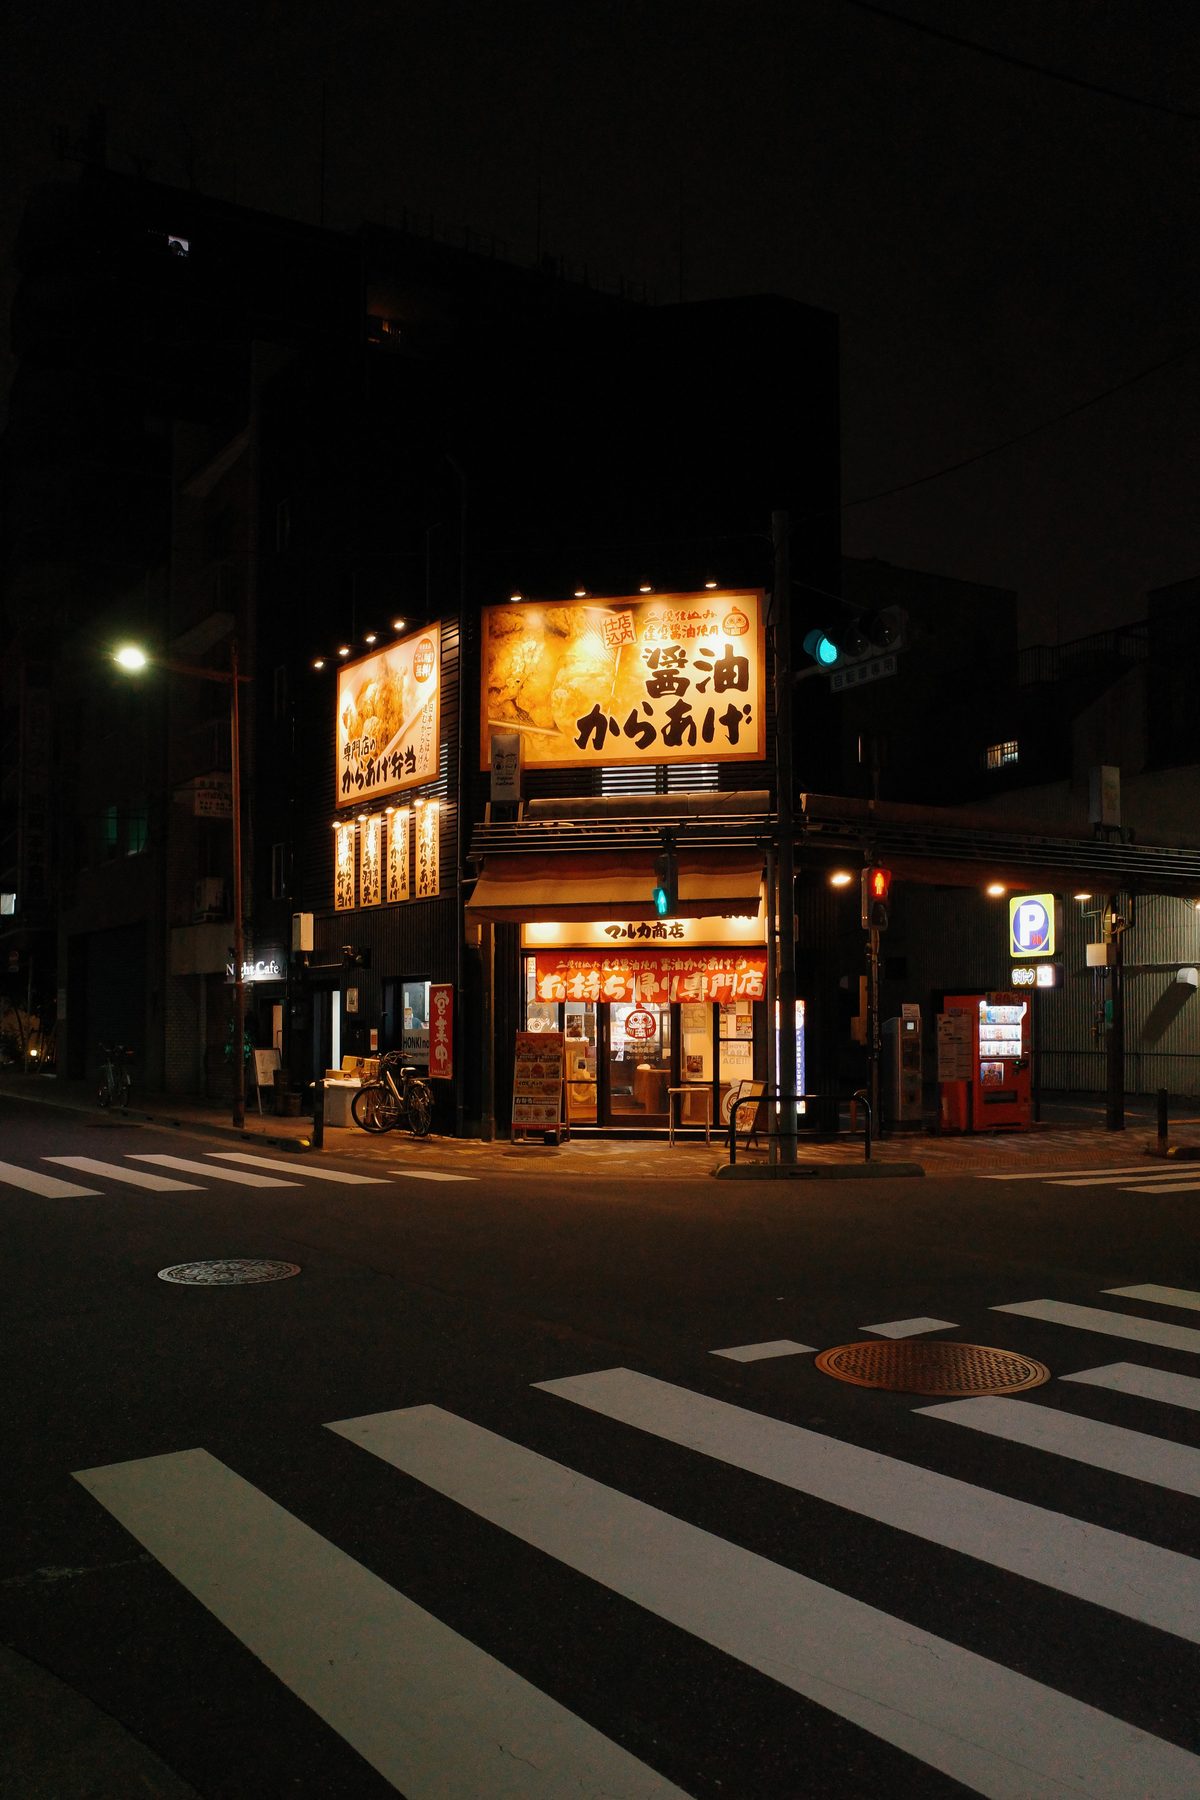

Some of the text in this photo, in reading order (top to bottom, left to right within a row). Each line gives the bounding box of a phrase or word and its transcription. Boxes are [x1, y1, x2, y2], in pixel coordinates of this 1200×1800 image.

[642, 643, 749, 698] 醤油
[574, 698, 752, 750] からあげ
[343, 736, 376, 762] 専門店の
[342, 744, 417, 794] からあげ弁当
[604, 922, 685, 940] マルカ商店
[256, 960, 280, 975] Cafe
[539, 970, 763, 1003] お持ち帰り専門店
[403, 1037, 421, 1049] HONKI
[434, 990, 449, 1069] 営業中
